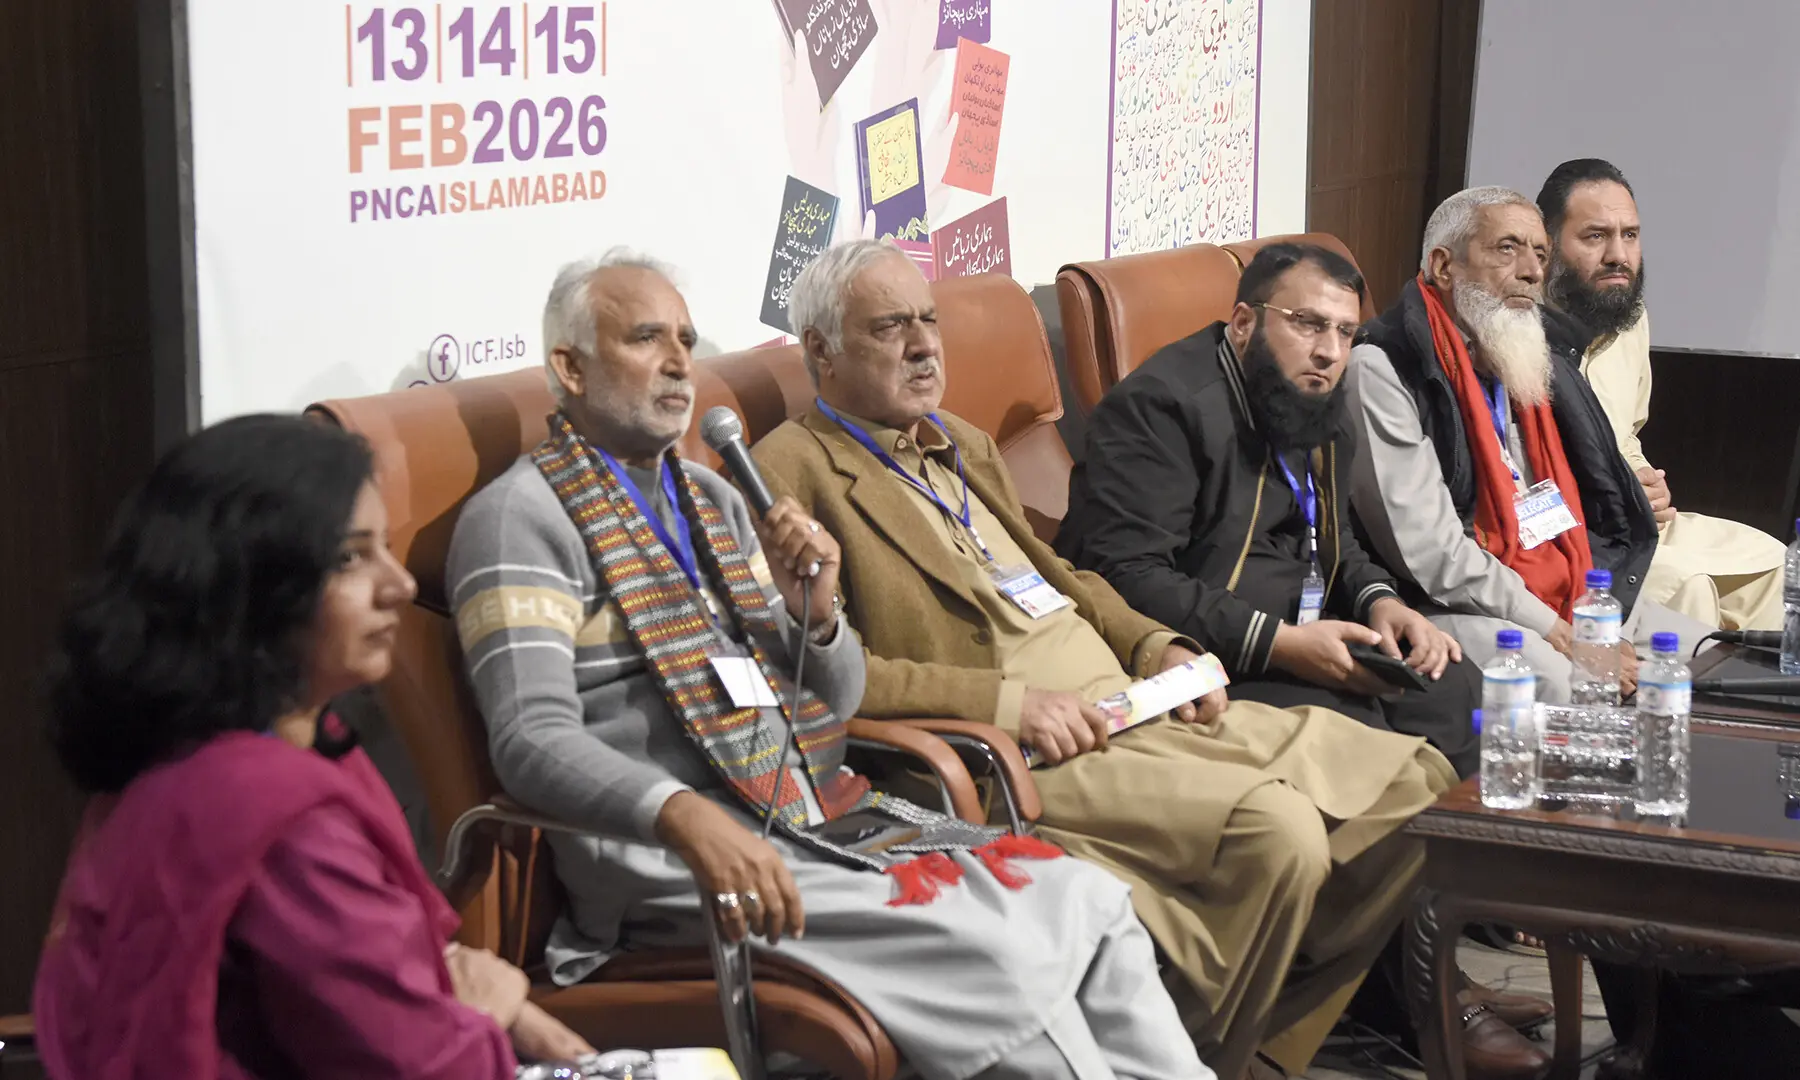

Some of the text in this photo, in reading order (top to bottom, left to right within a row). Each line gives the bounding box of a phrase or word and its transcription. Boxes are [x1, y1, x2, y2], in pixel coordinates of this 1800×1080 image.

[357, 5, 596, 81] 13 14 15
[1203, 0, 1228, 60] بلوچی
[1211, 91, 1235, 124] اردو
[945, 222, 993, 268] ہماری زبانیں
[981, 245, 1004, 273] ہماری
